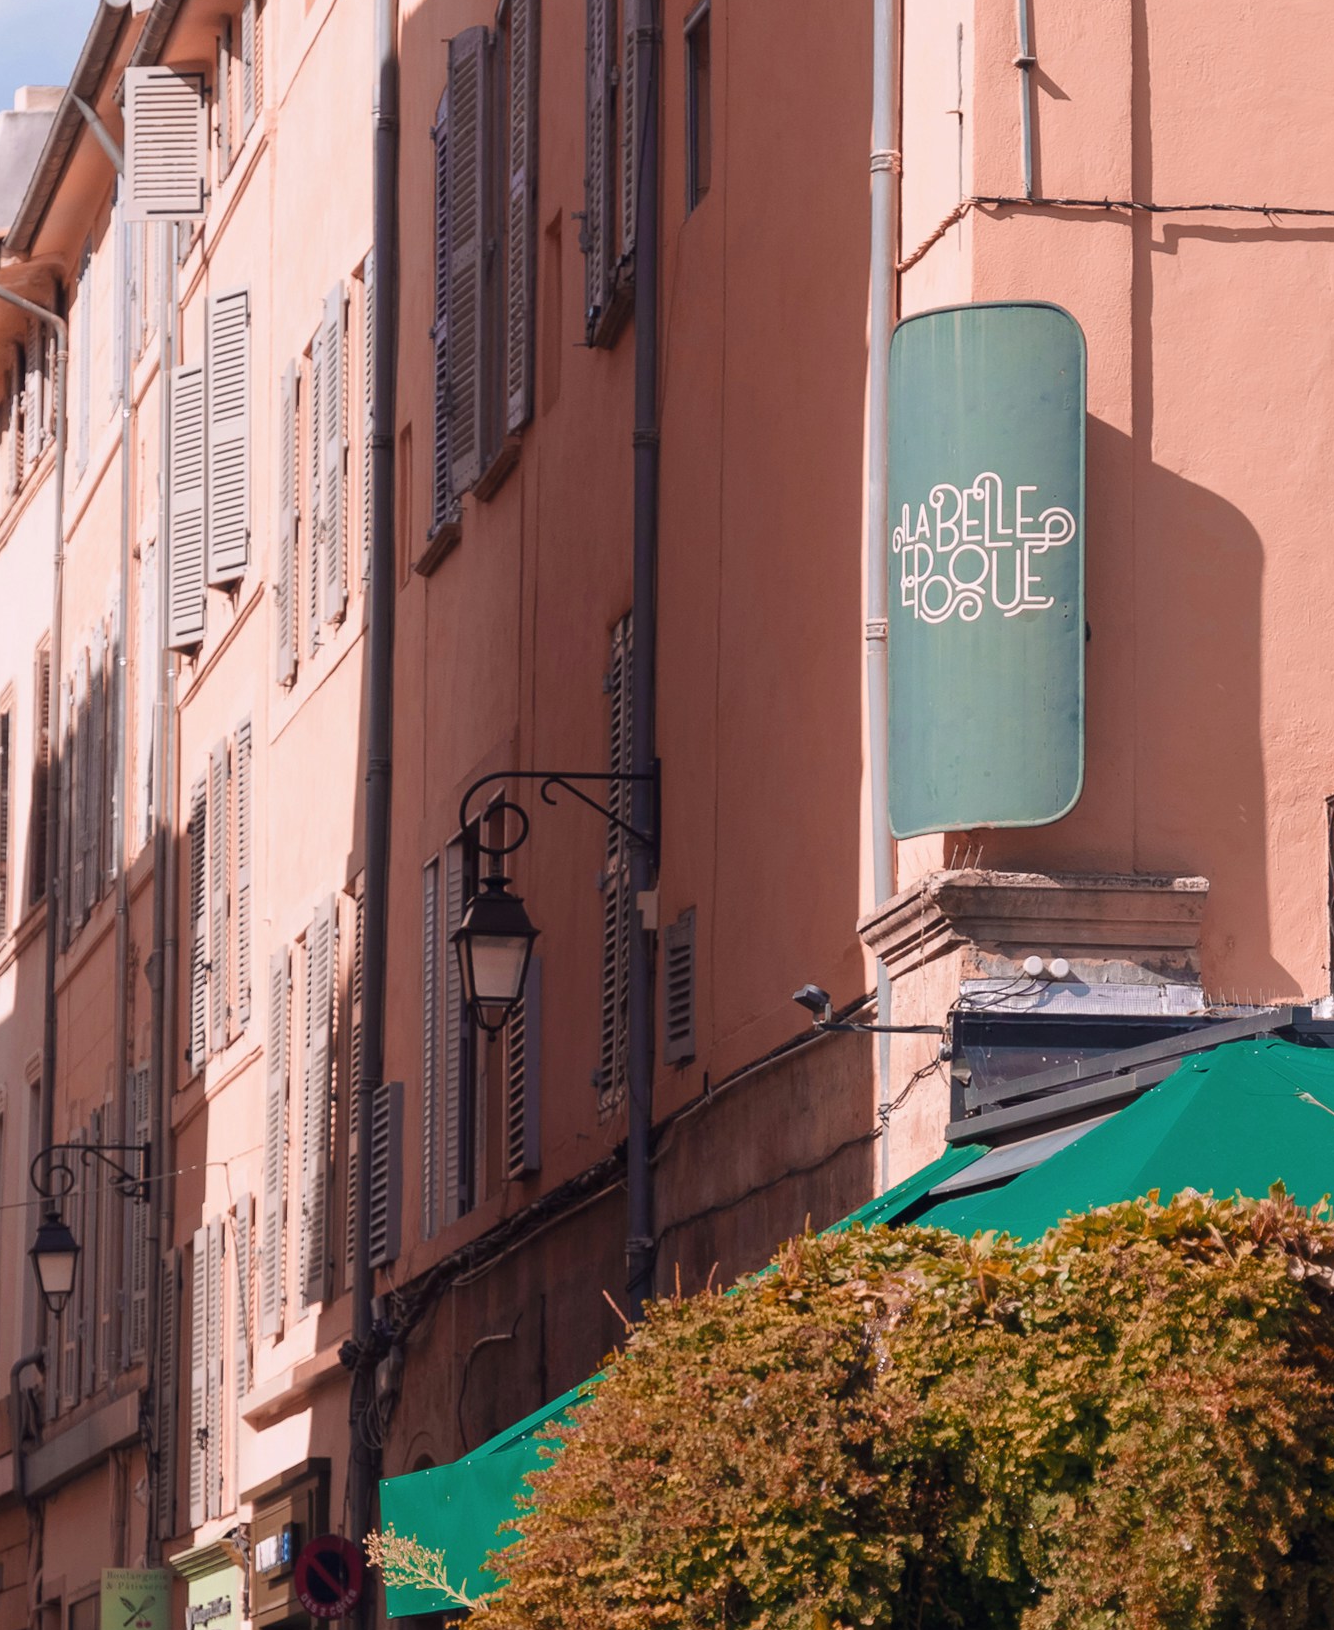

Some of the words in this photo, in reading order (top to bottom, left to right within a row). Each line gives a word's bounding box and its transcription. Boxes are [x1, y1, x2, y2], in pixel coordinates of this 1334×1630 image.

[893, 502, 931, 554] LA
[929, 471, 1076, 555] BELLE
[900, 540, 1055, 624] EPOQUE
[300, 1592, 317, 1613] DES
[319, 1607, 327, 1617] 2
